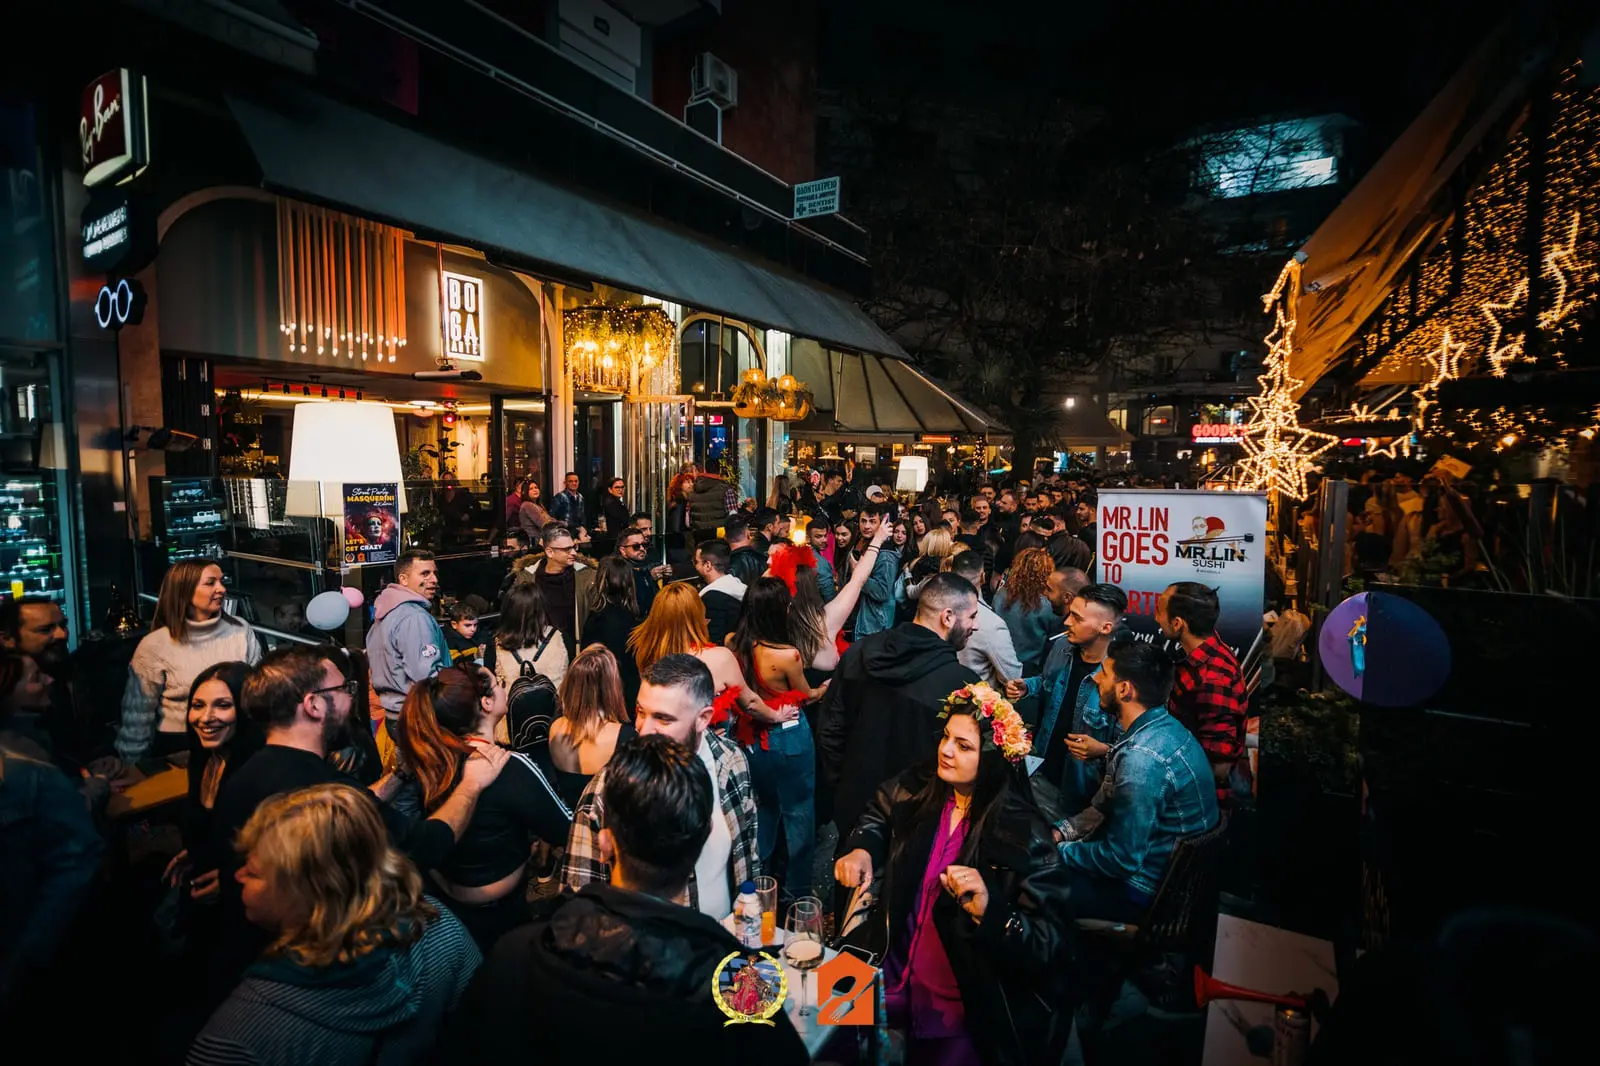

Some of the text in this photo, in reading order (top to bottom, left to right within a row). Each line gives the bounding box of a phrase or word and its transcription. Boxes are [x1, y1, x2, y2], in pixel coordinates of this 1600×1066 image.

[1102, 506, 1169, 532] MR.LIN
[360, 543, 383, 551] CRAZY
[1102, 531, 1169, 566] GOES
[1175, 545, 1246, 562] MR.LIN
[1102, 563, 1122, 584] TO
[1192, 559, 1226, 569] SUSHI
